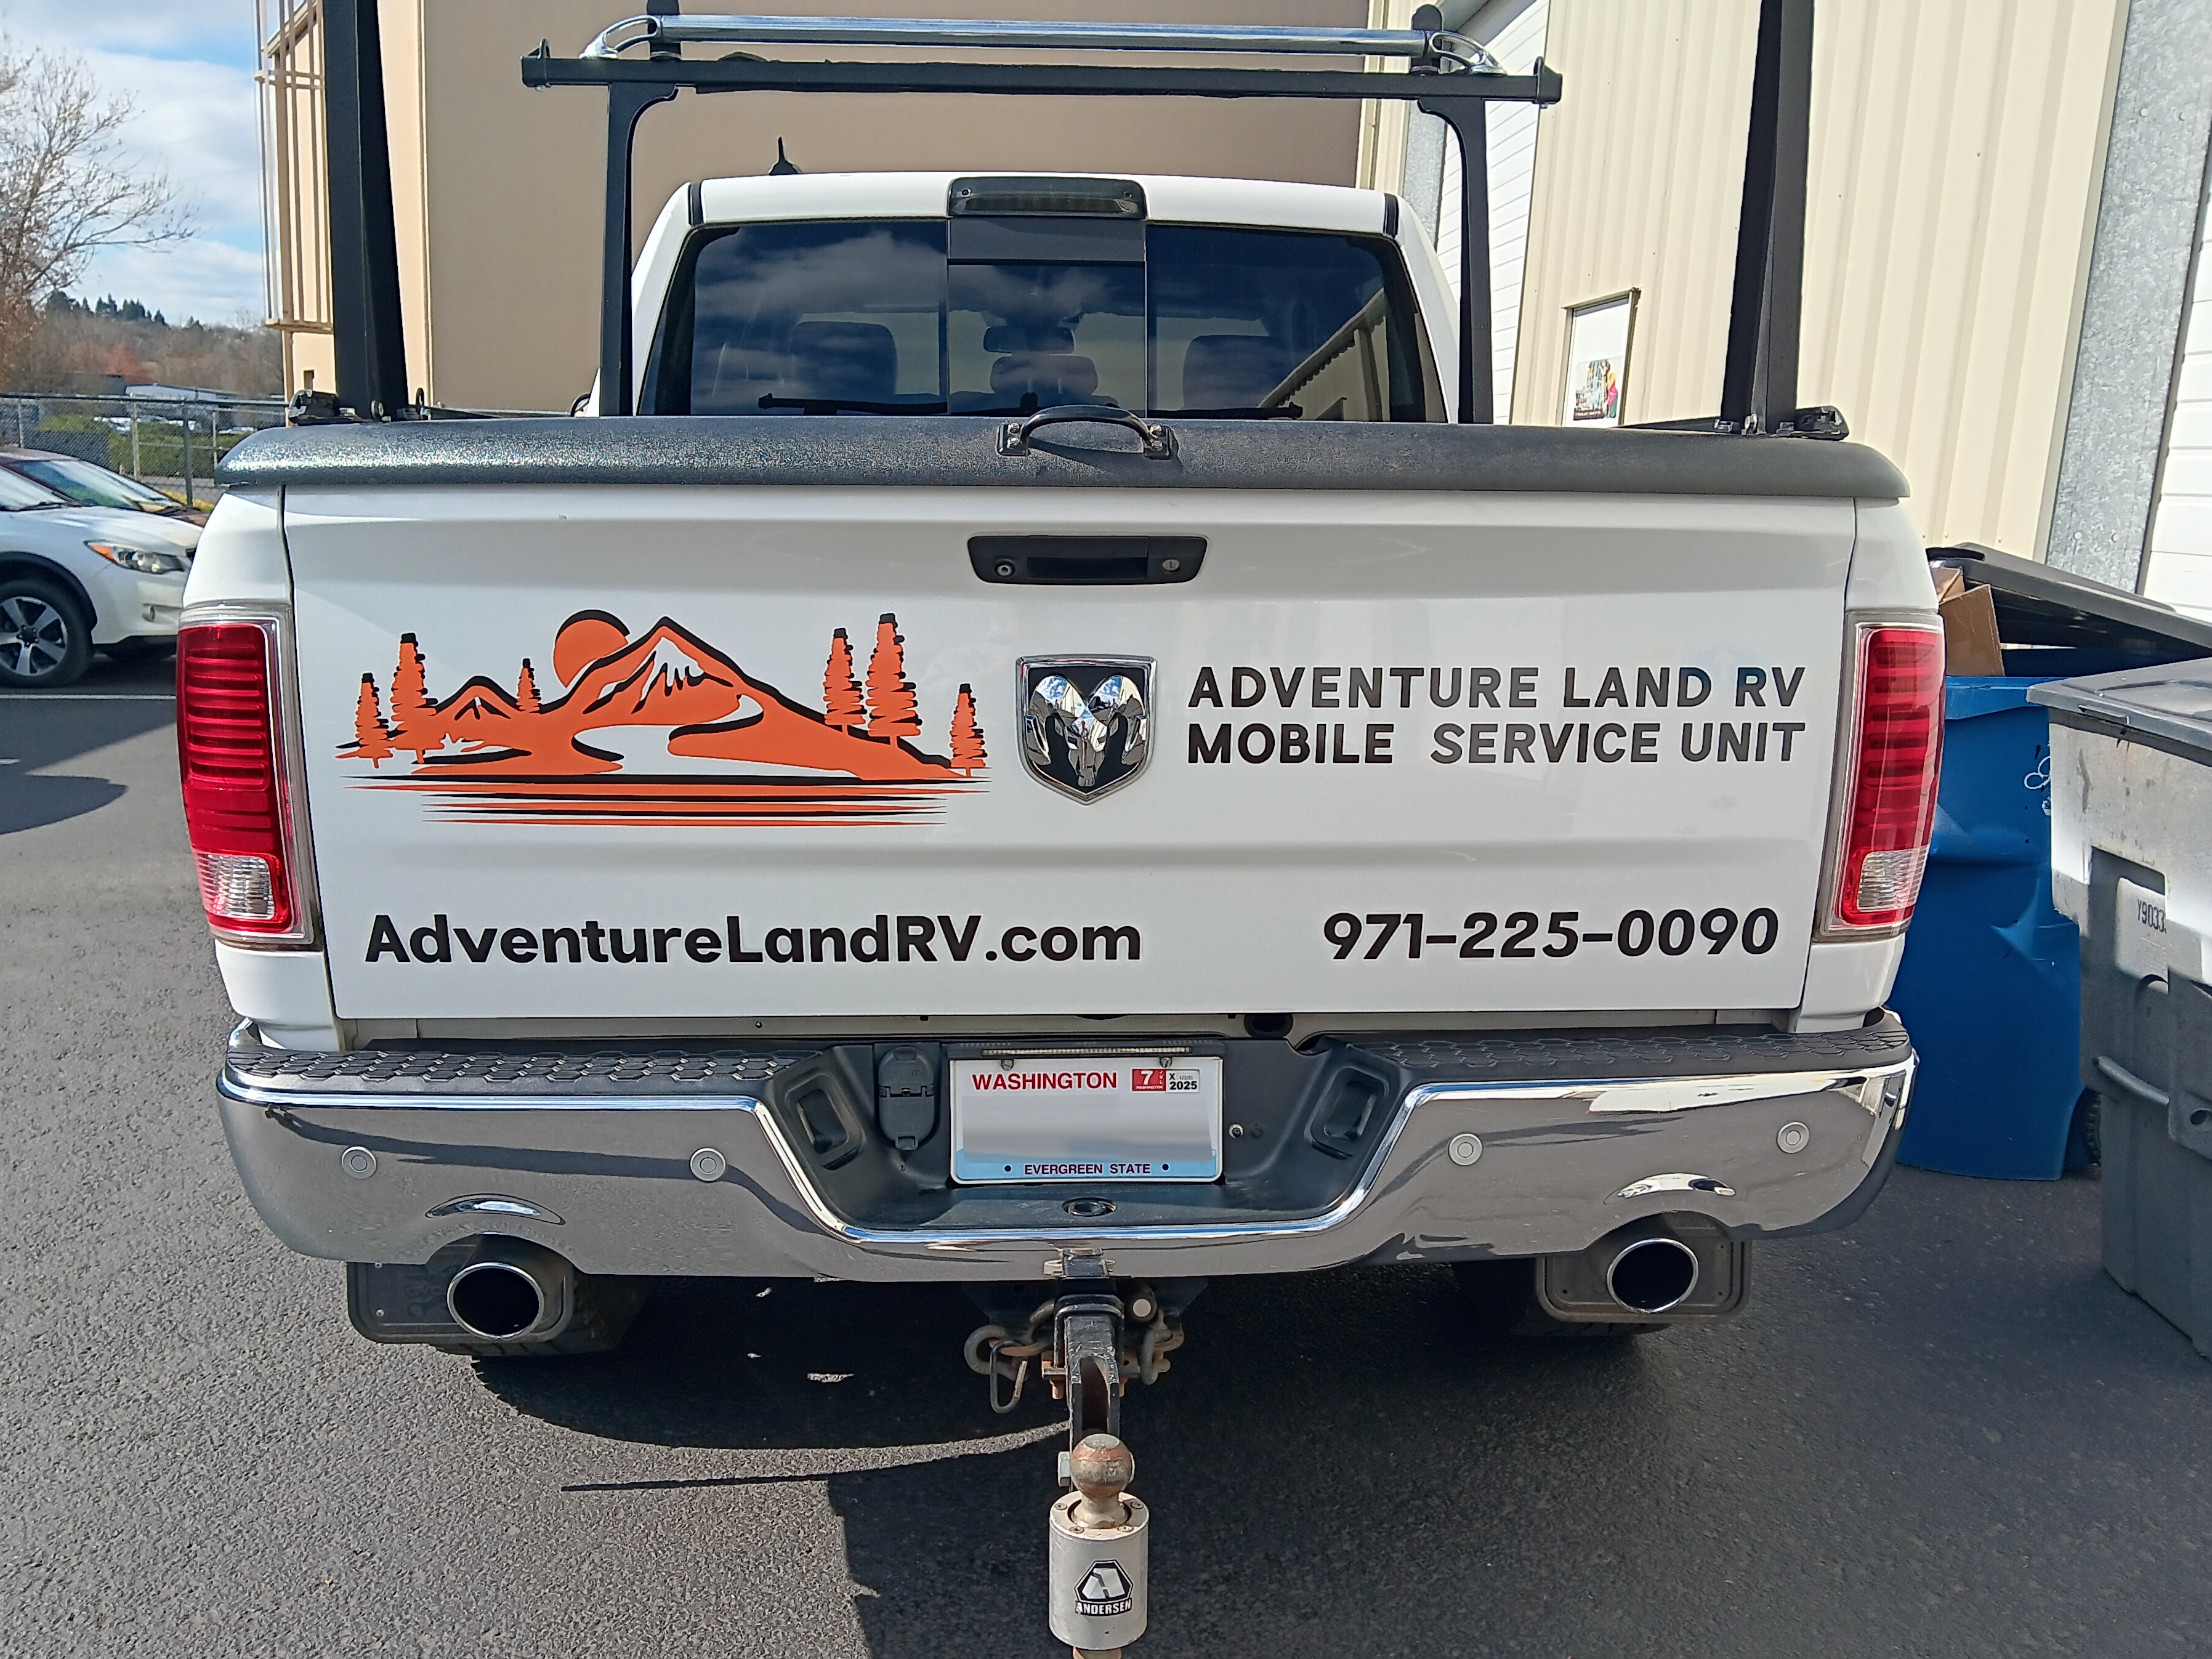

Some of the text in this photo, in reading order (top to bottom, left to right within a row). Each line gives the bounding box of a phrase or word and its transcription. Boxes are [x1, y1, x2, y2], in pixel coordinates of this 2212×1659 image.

[1187, 666, 1806, 708] ADVENTURE LAND RV
[1188, 722, 1806, 764] MOBILE SERVICE UNIT
[2137, 898, 2166, 934] Y9033
[365, 914, 1140, 964] AdventureLandRV.com
[1323, 907, 1778, 959] 971-225-0090
[972, 1072, 1117, 1091] WASHINGTON
[1140, 1070, 1153, 1086] 7
[1169, 1073, 1176, 1081] X
[1169, 1081, 1197, 1090] 2025
[1025, 1163, 1151, 1175] EVERGREEN STATE
[1076, 1599, 1131, 1615] ANDERSEN
